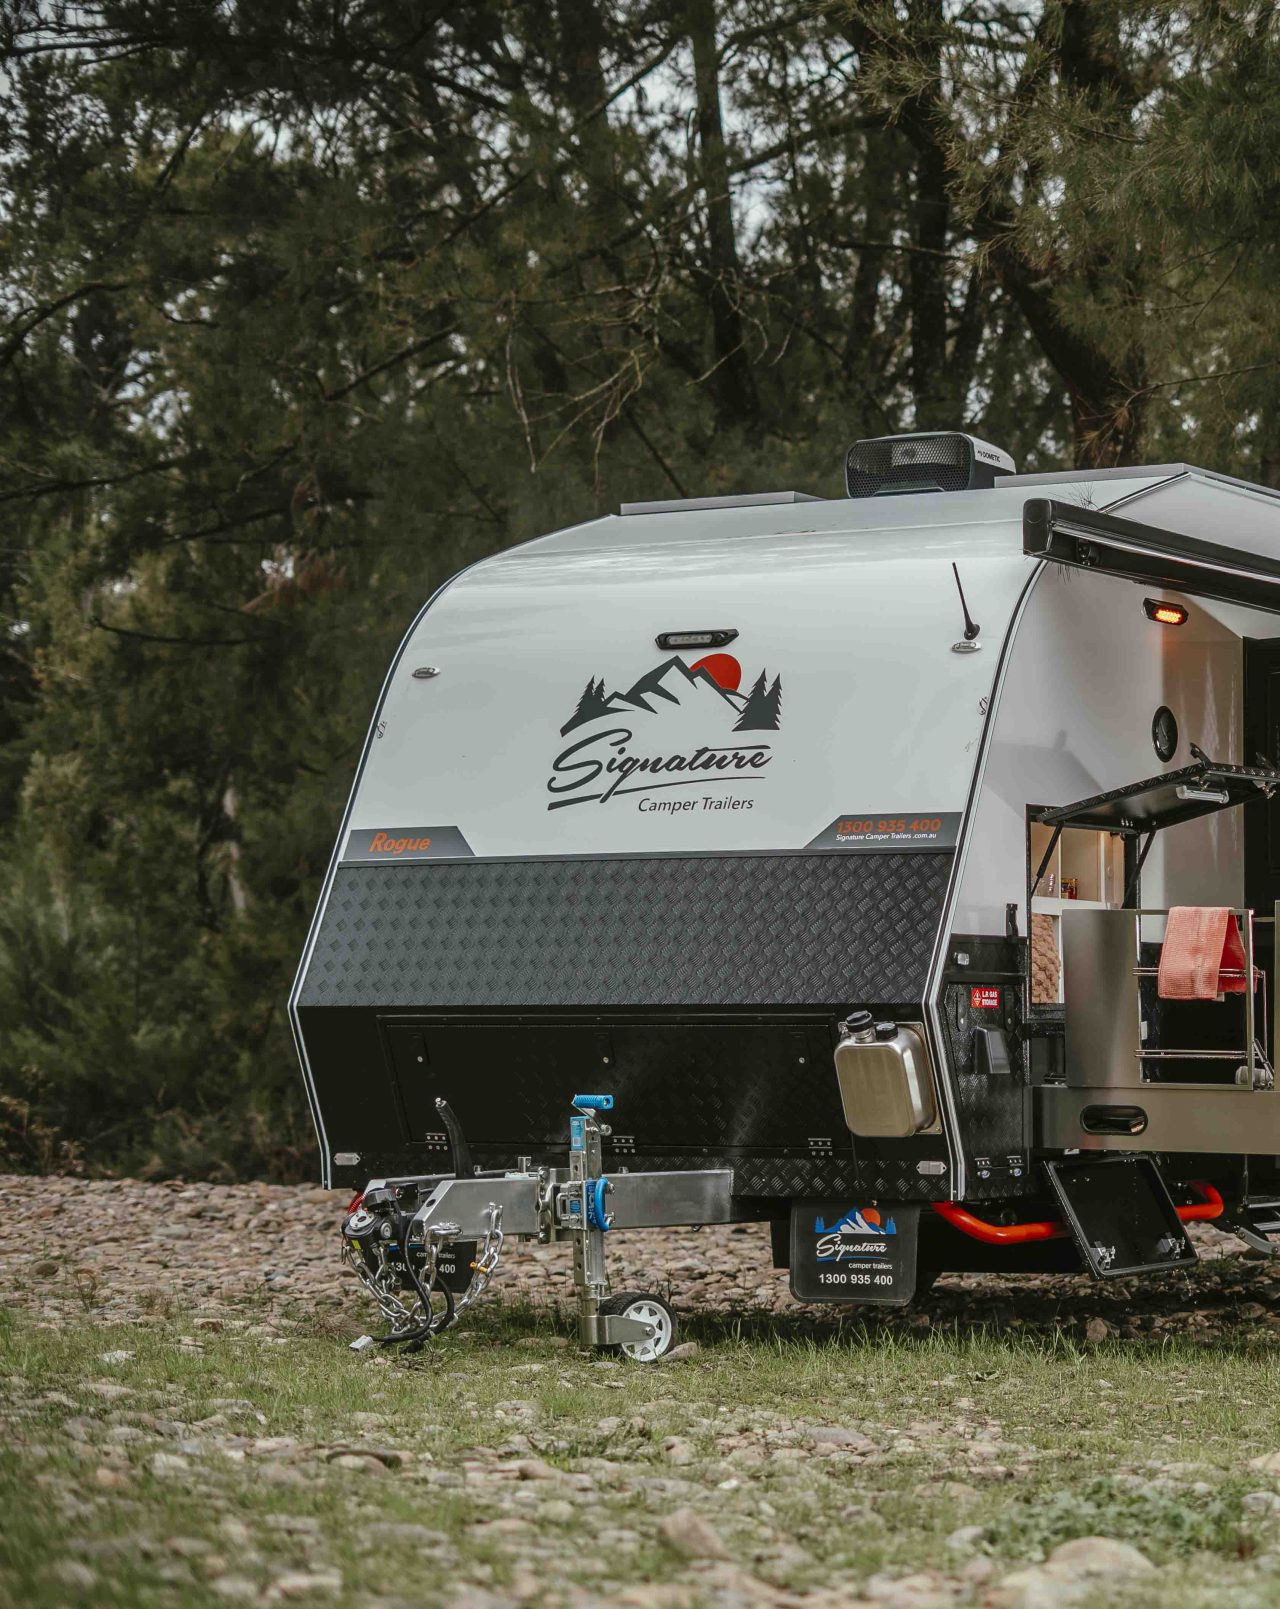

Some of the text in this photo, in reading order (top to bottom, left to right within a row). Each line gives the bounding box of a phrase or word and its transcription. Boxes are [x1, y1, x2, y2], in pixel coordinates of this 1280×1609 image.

[983, 451, 1001, 462] DOMETIC
[547, 728, 773, 803] Signature
[637, 797, 754, 815] Camper Trailers
[837, 818, 941, 833] 1300 935 400
[369, 832, 432, 855] Rogue
[865, 833, 889, 841] Camper
[890, 832, 912, 840] Trailers
[816, 1233, 887, 1262] Signature
[439, 1264, 455, 1273] 400
[848, 1262, 893, 1270] camper trailers
[819, 1273, 893, 1286] 1300 935 400
